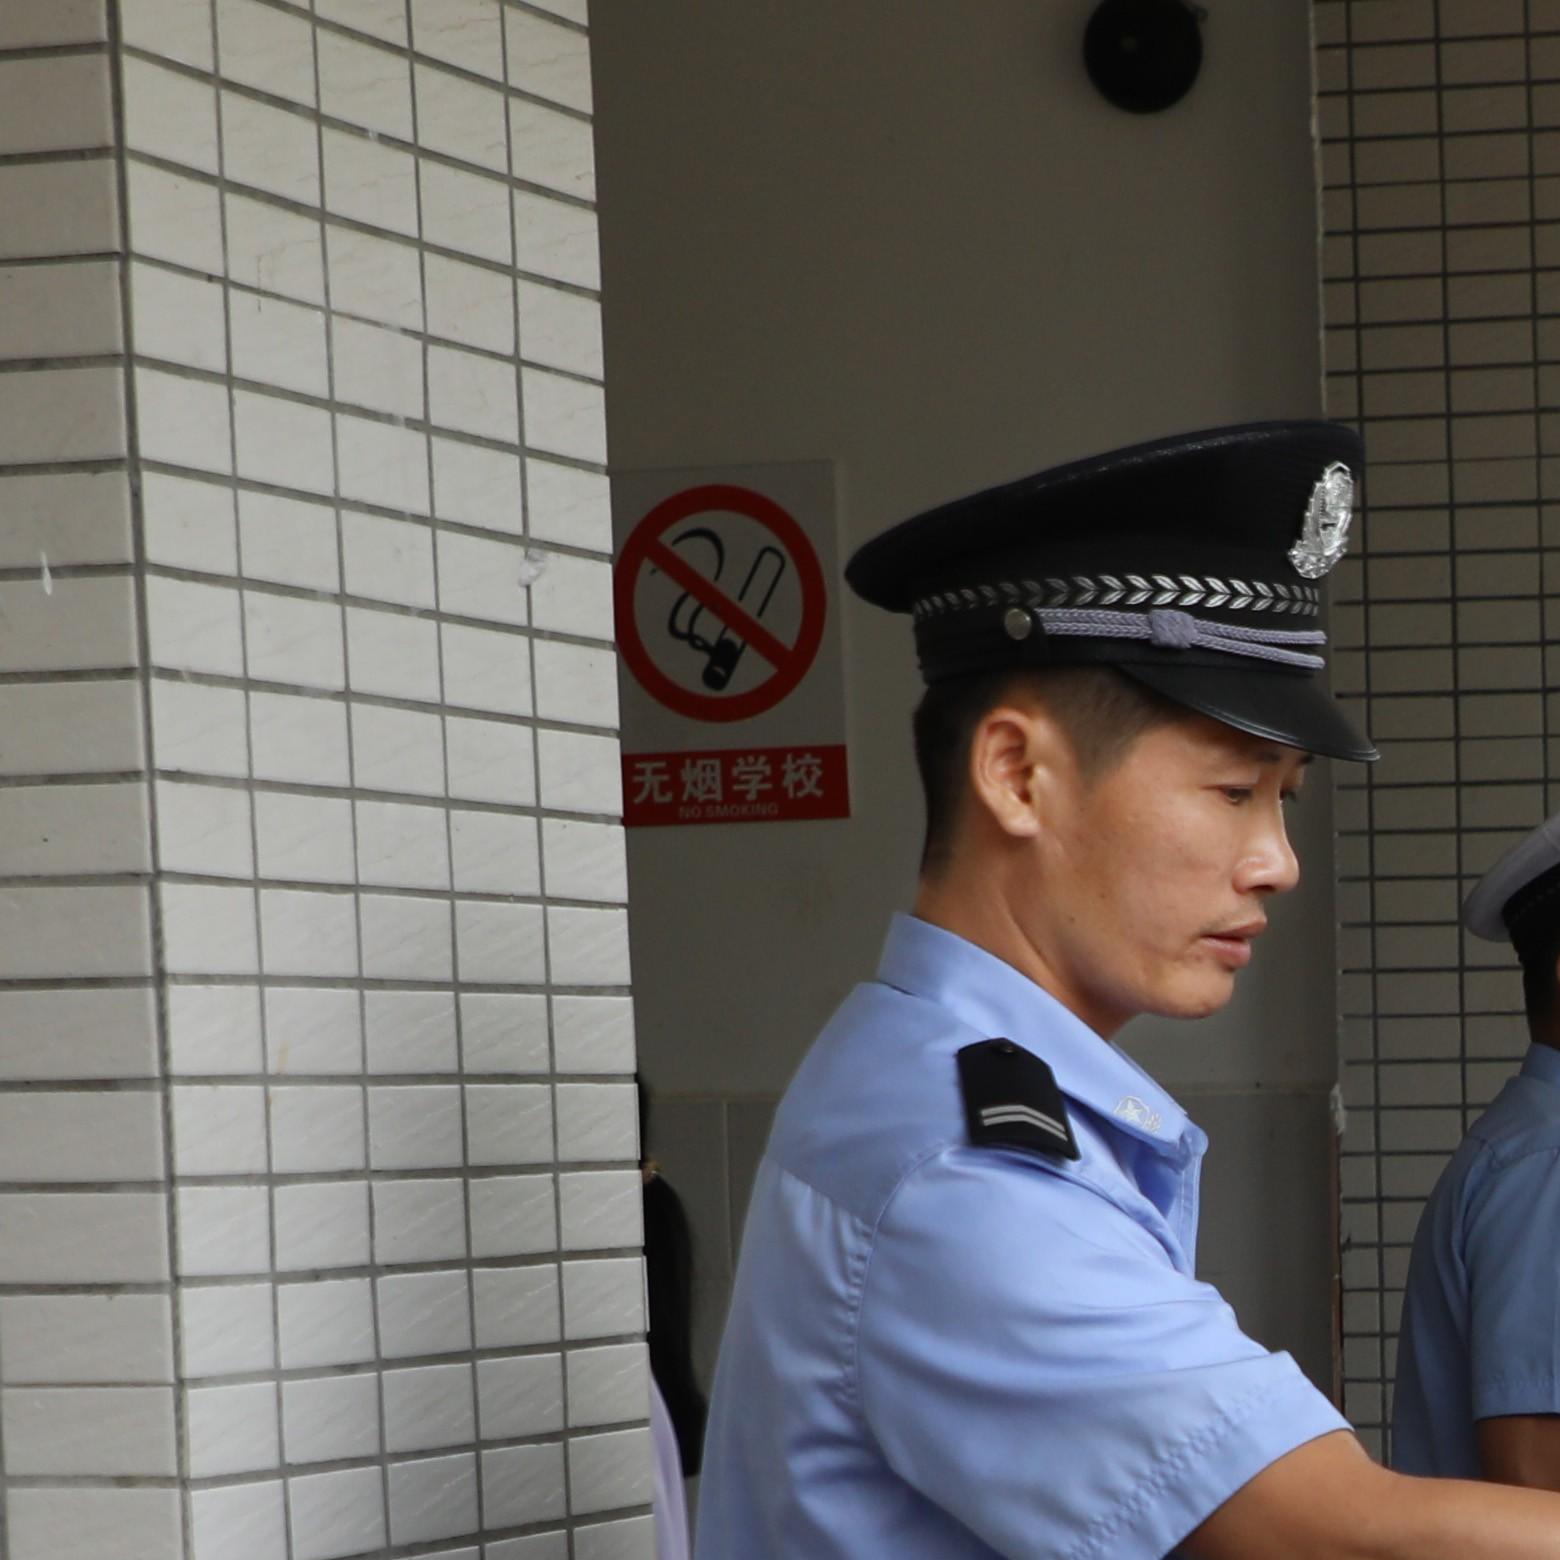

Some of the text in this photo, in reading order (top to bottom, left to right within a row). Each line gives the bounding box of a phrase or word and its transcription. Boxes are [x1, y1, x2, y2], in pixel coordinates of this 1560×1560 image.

[633, 753, 824, 804] 无烟学校
[680, 803, 779, 819] NO SMOKING
